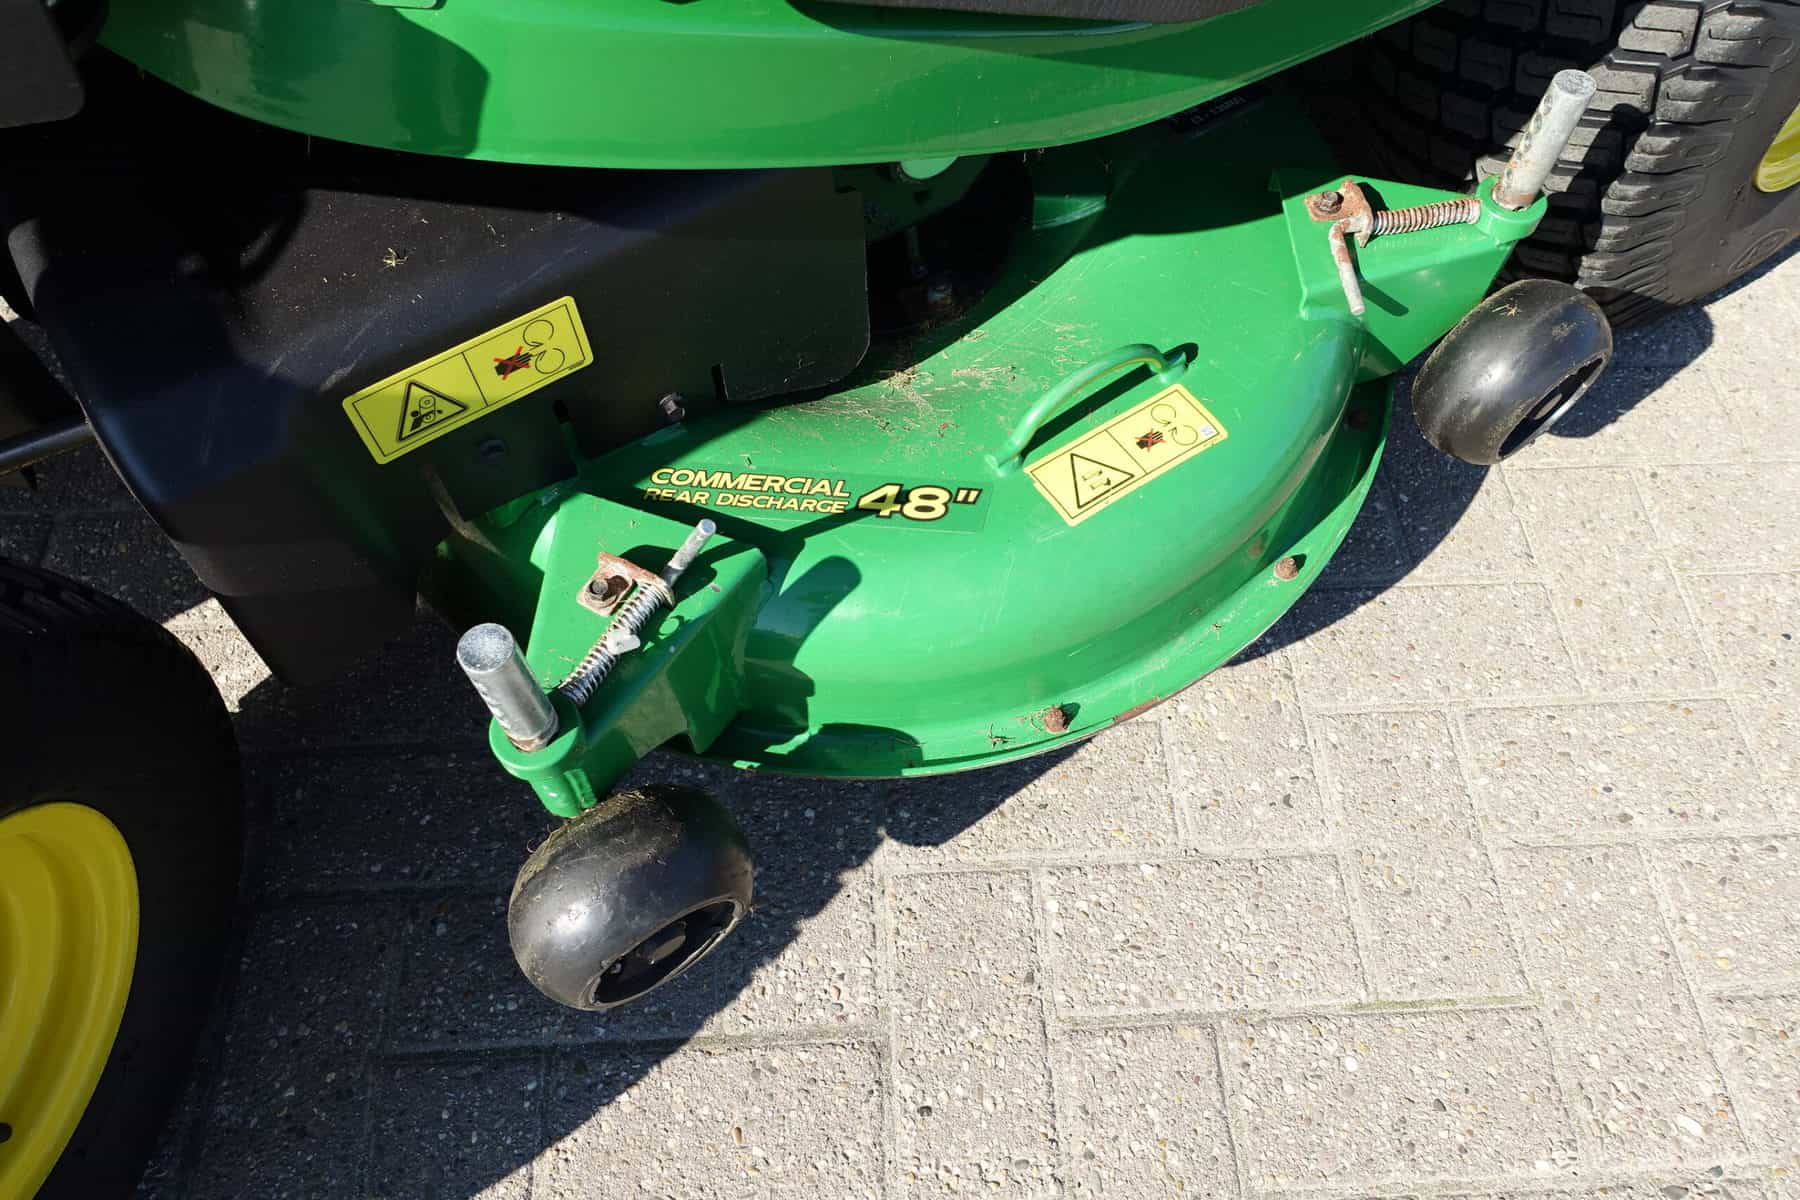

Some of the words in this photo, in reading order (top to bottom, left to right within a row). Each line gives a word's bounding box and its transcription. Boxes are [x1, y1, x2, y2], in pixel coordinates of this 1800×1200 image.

[650, 467, 851, 498] COMMERCIAL
[644, 487, 710, 505] REAR
[715, 494, 850, 514] DISCHARGE
[857, 482, 983, 520] 48"
